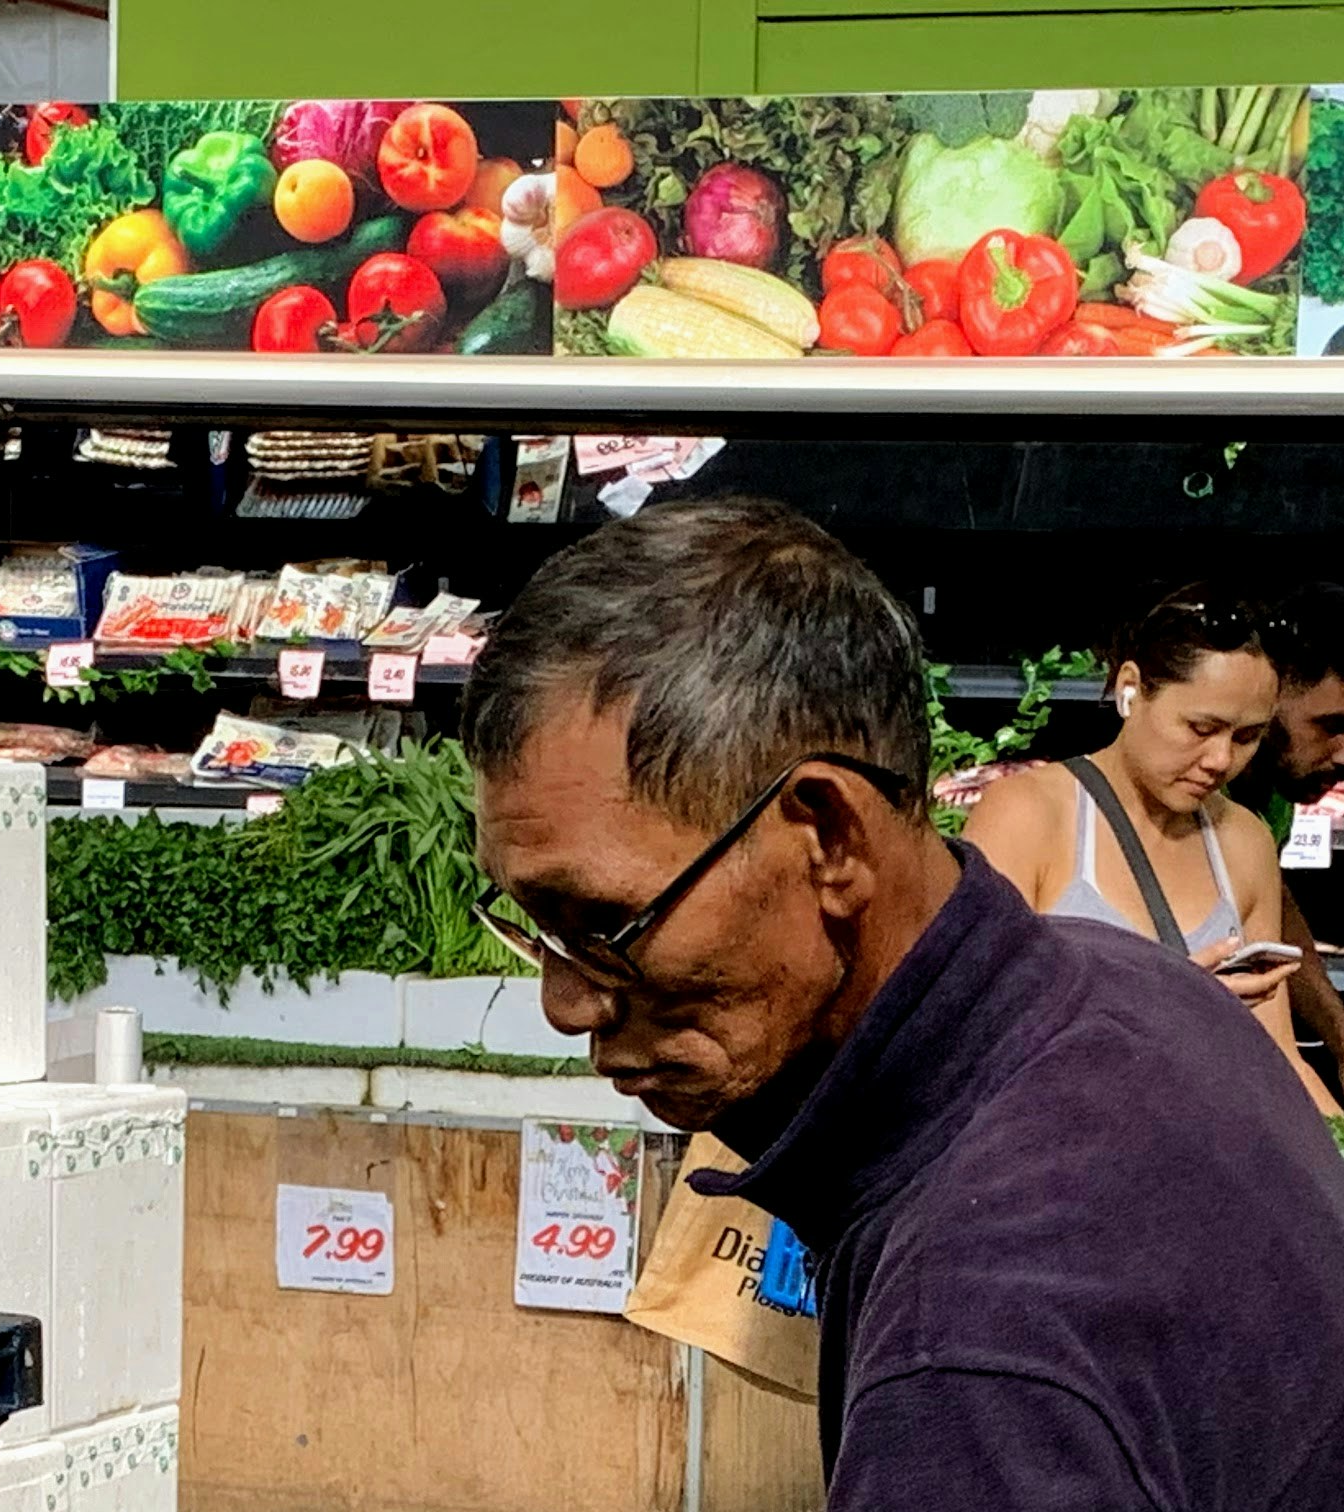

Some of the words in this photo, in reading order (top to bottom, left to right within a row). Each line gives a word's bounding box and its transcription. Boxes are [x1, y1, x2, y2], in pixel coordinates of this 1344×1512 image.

[302, 1223, 385, 1263] 7.99
[532, 1223, 617, 1260] 4.99
[711, 1226, 768, 1273] Dia
